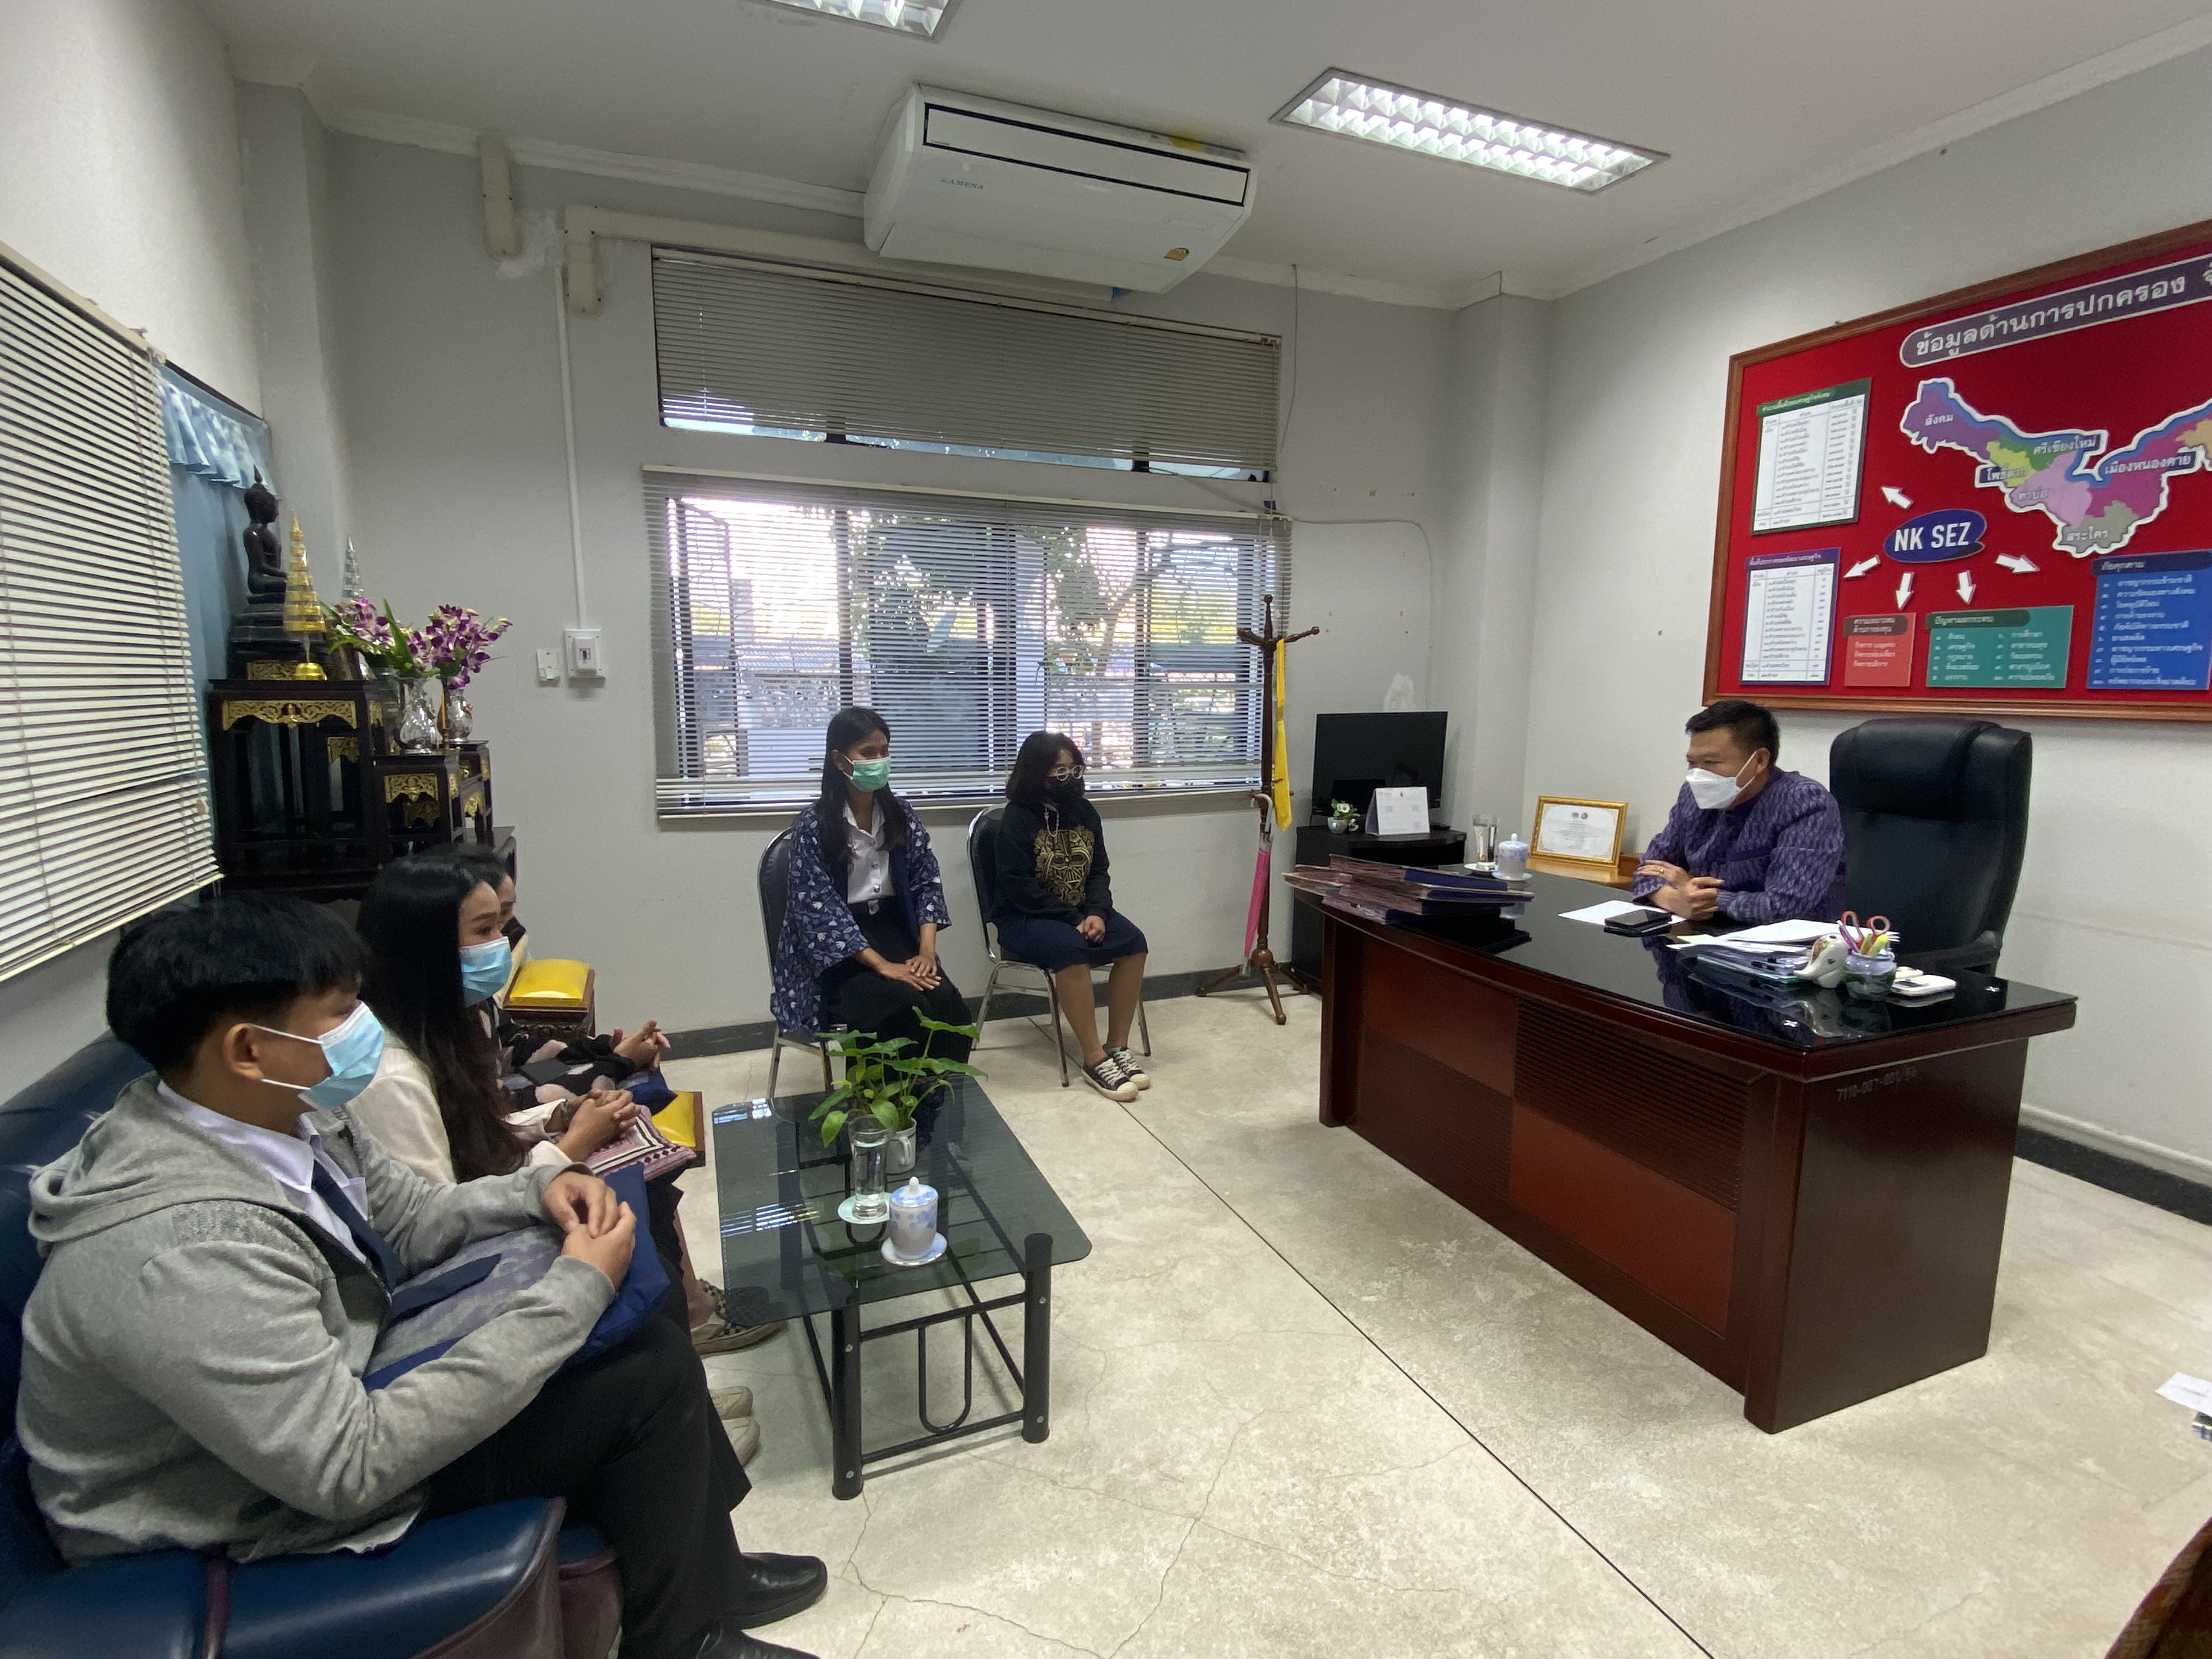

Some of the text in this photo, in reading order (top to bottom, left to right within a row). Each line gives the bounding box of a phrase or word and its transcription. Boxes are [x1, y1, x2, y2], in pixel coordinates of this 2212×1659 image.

[1916, 275, 2187, 357] ข้อมูลด้านการปกครอง
[1925, 414, 1954, 426] สังคม
[2104, 455, 2192, 475] เมืองหนองคาย
[1894, 521, 1972, 552] NK SEZ
